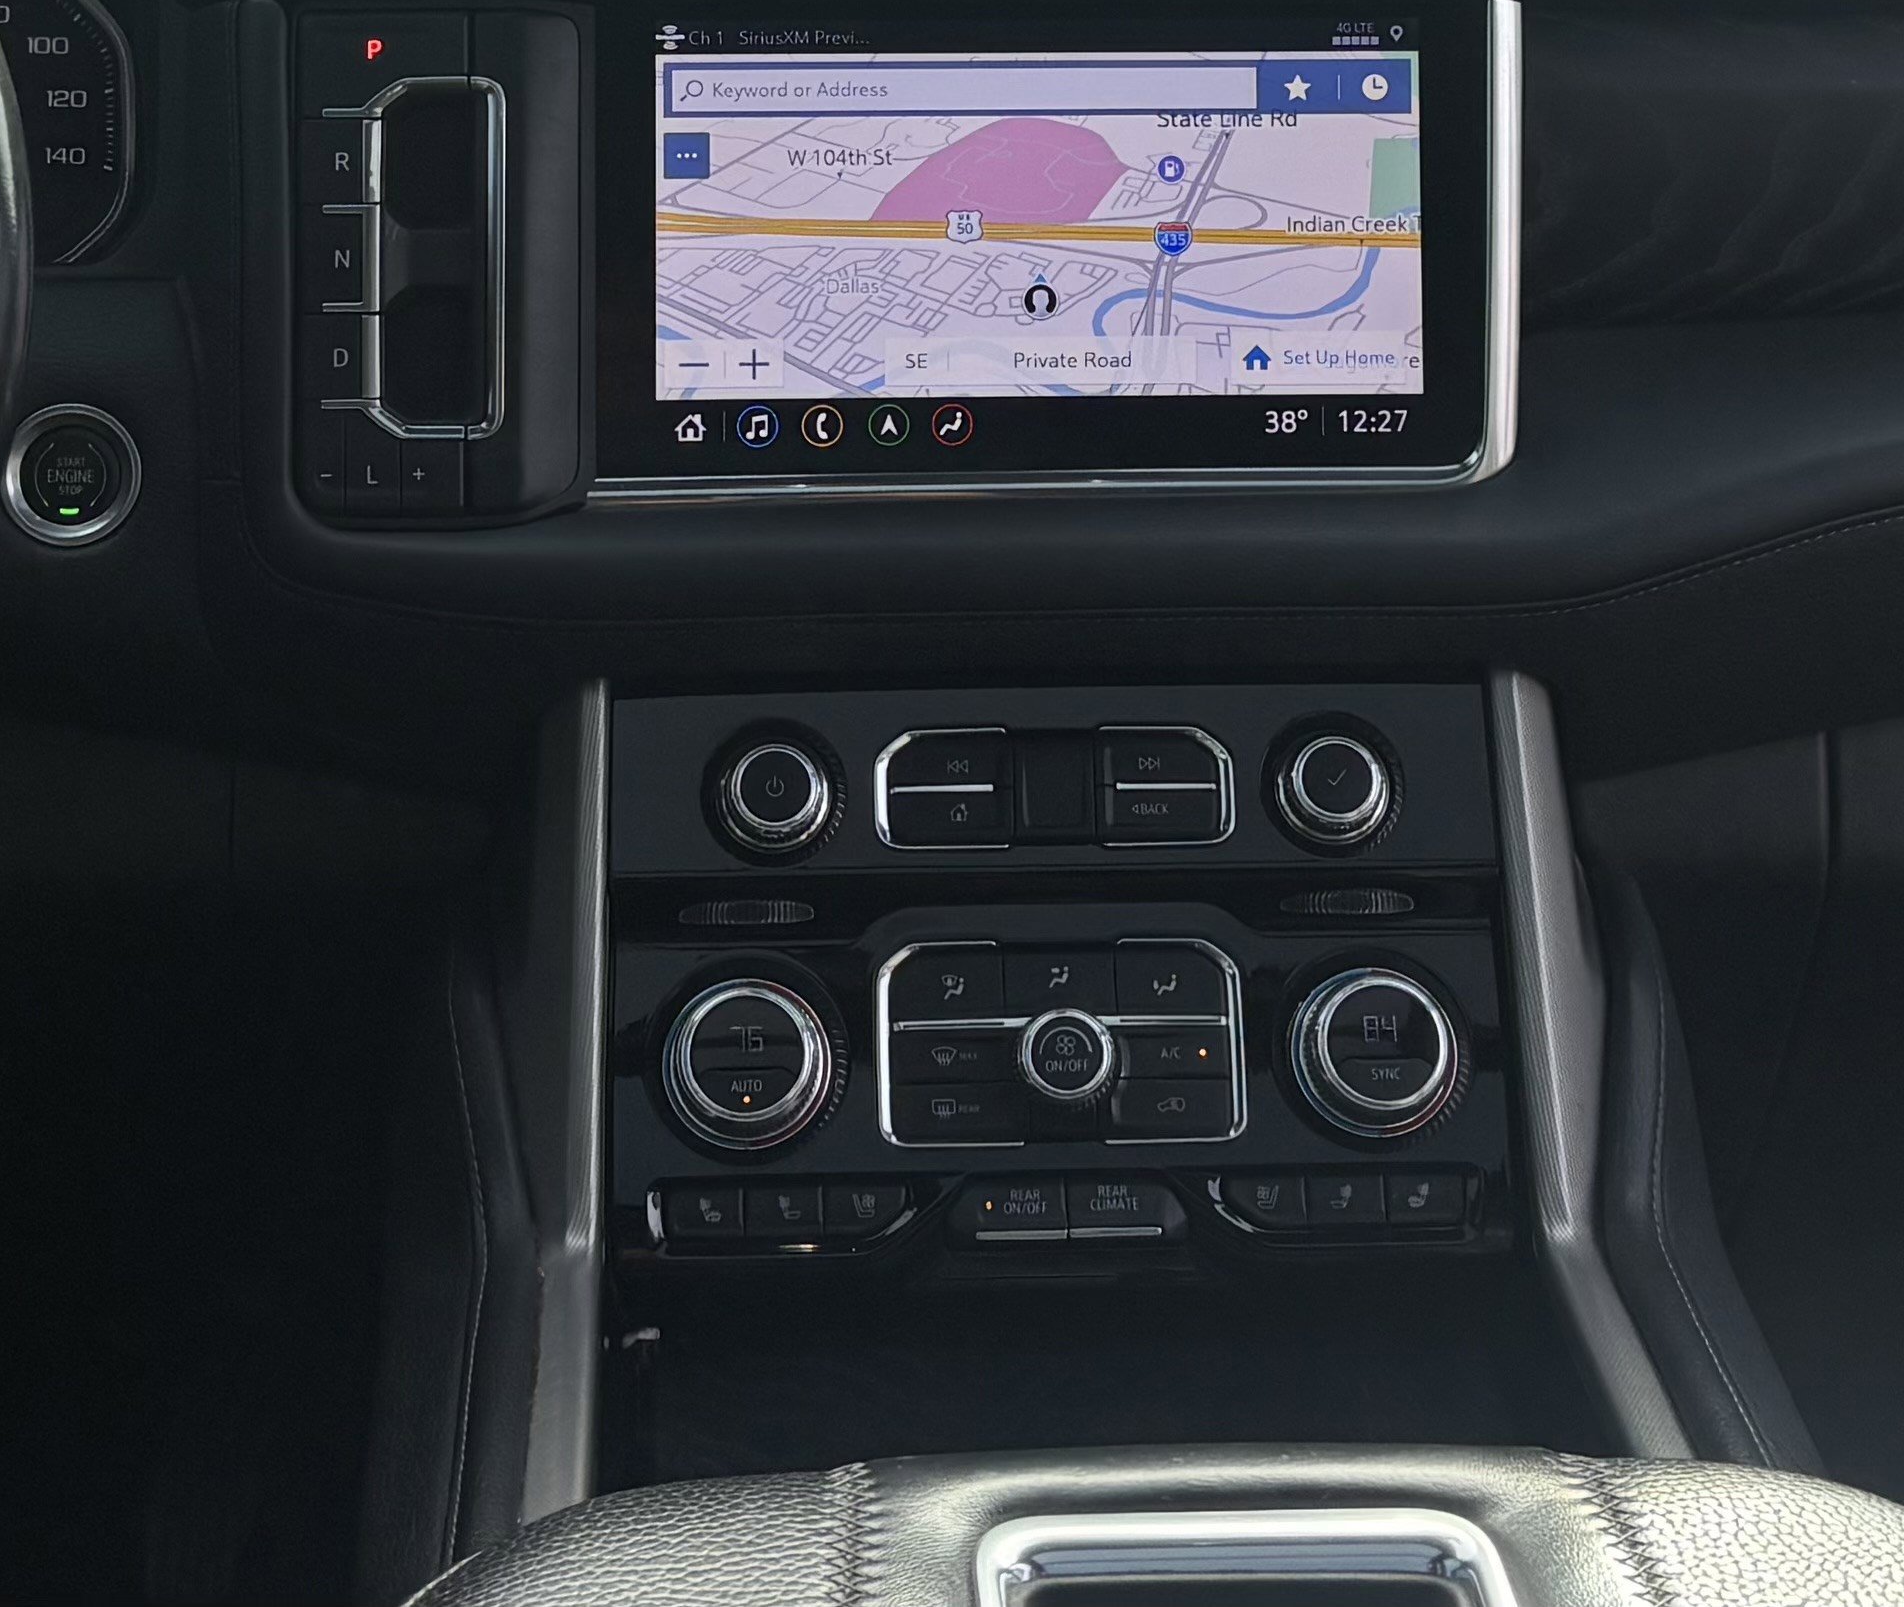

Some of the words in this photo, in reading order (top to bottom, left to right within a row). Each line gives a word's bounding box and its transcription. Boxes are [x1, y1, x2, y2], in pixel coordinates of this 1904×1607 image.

[1353, 22, 1374, 33] LTE
[28, 36, 69, 55] 100
[688, 30, 710, 45] Ch
[717, 31, 724, 45] 1
[739, 30, 809, 45] SiriusXM
[365, 38, 384, 60] P
[47, 90, 88, 108] 120
[712, 81, 788, 102] Keyword
[793, 85, 811, 97] or
[816, 81, 888, 97] Address
[1157, 110, 1212, 128] State
[1220, 110, 1263, 128] Line
[1270, 108, 1297, 128] Rd
[46, 146, 86, 165] 140
[334, 151, 350, 171] R
[787, 149, 806, 166] W
[813, 148, 867, 166] 104th
[873, 148, 893, 166] St
[956, 222, 974, 236] 50
[1287, 216, 1345, 233] Indian
[1351, 215, 1408, 233] Creek
[1161, 233, 1186, 246] 435
[334, 249, 350, 269] N
[826, 278, 879, 294] Dallas
[332, 347, 349, 368] D
[905, 352, 928, 369] SE
[1014, 351, 1078, 369] Private
[1084, 351, 1132, 369] Road
[1283, 349, 1311, 365] Set
[1315, 349, 1339, 368] Up
[1345, 349, 1395, 365] Home
[1264, 409, 1308, 434] 38°
[1338, 409, 1408, 433] 12:27
[47, 468, 95, 484] ENGINE
[365, 465, 378, 485] L
[58, 484, 84, 495] STOP
[1140, 802, 1169, 815] BACK
[1363, 1015, 1398, 1042] 84
[1160, 1046, 1182, 1059] A/C
[1045, 1058, 1089, 1072] ON/OFF
[1370, 1067, 1401, 1081] SYNC
[730, 1079, 763, 1093] AUTO
[1009, 1188, 1041, 1201] REAR
[1097, 1184, 1128, 1197] REAR
[1003, 1201, 1047, 1215] ON/OFF
[1089, 1197, 1139, 1212] CLIMATE
